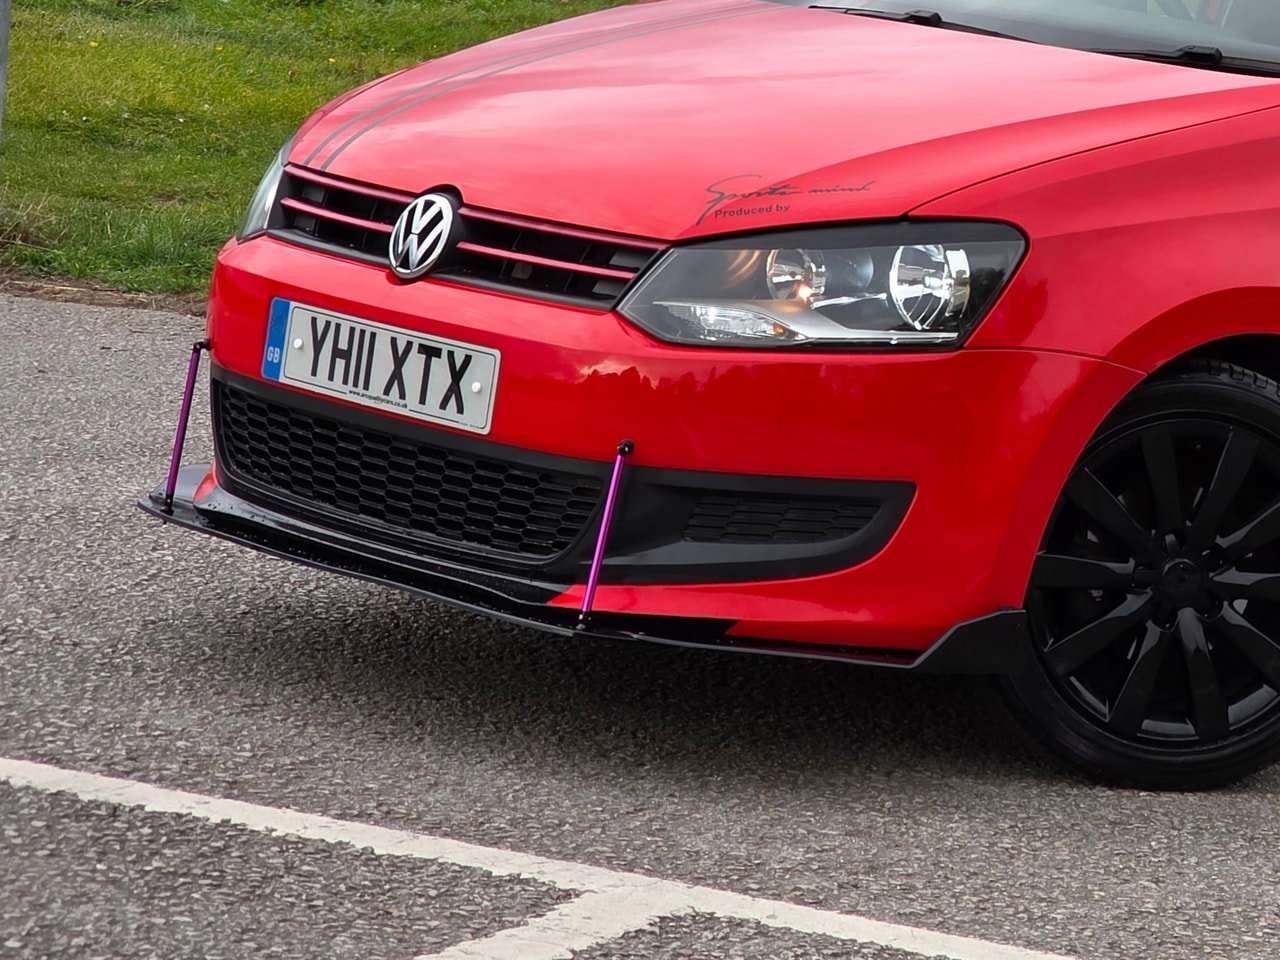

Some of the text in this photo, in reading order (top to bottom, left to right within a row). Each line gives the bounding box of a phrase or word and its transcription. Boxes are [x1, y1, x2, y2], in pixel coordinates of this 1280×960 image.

[714, 203, 791, 219] Produced by
[267, 346, 281, 363] GB
[310, 316, 473, 415] YH11 XTX
